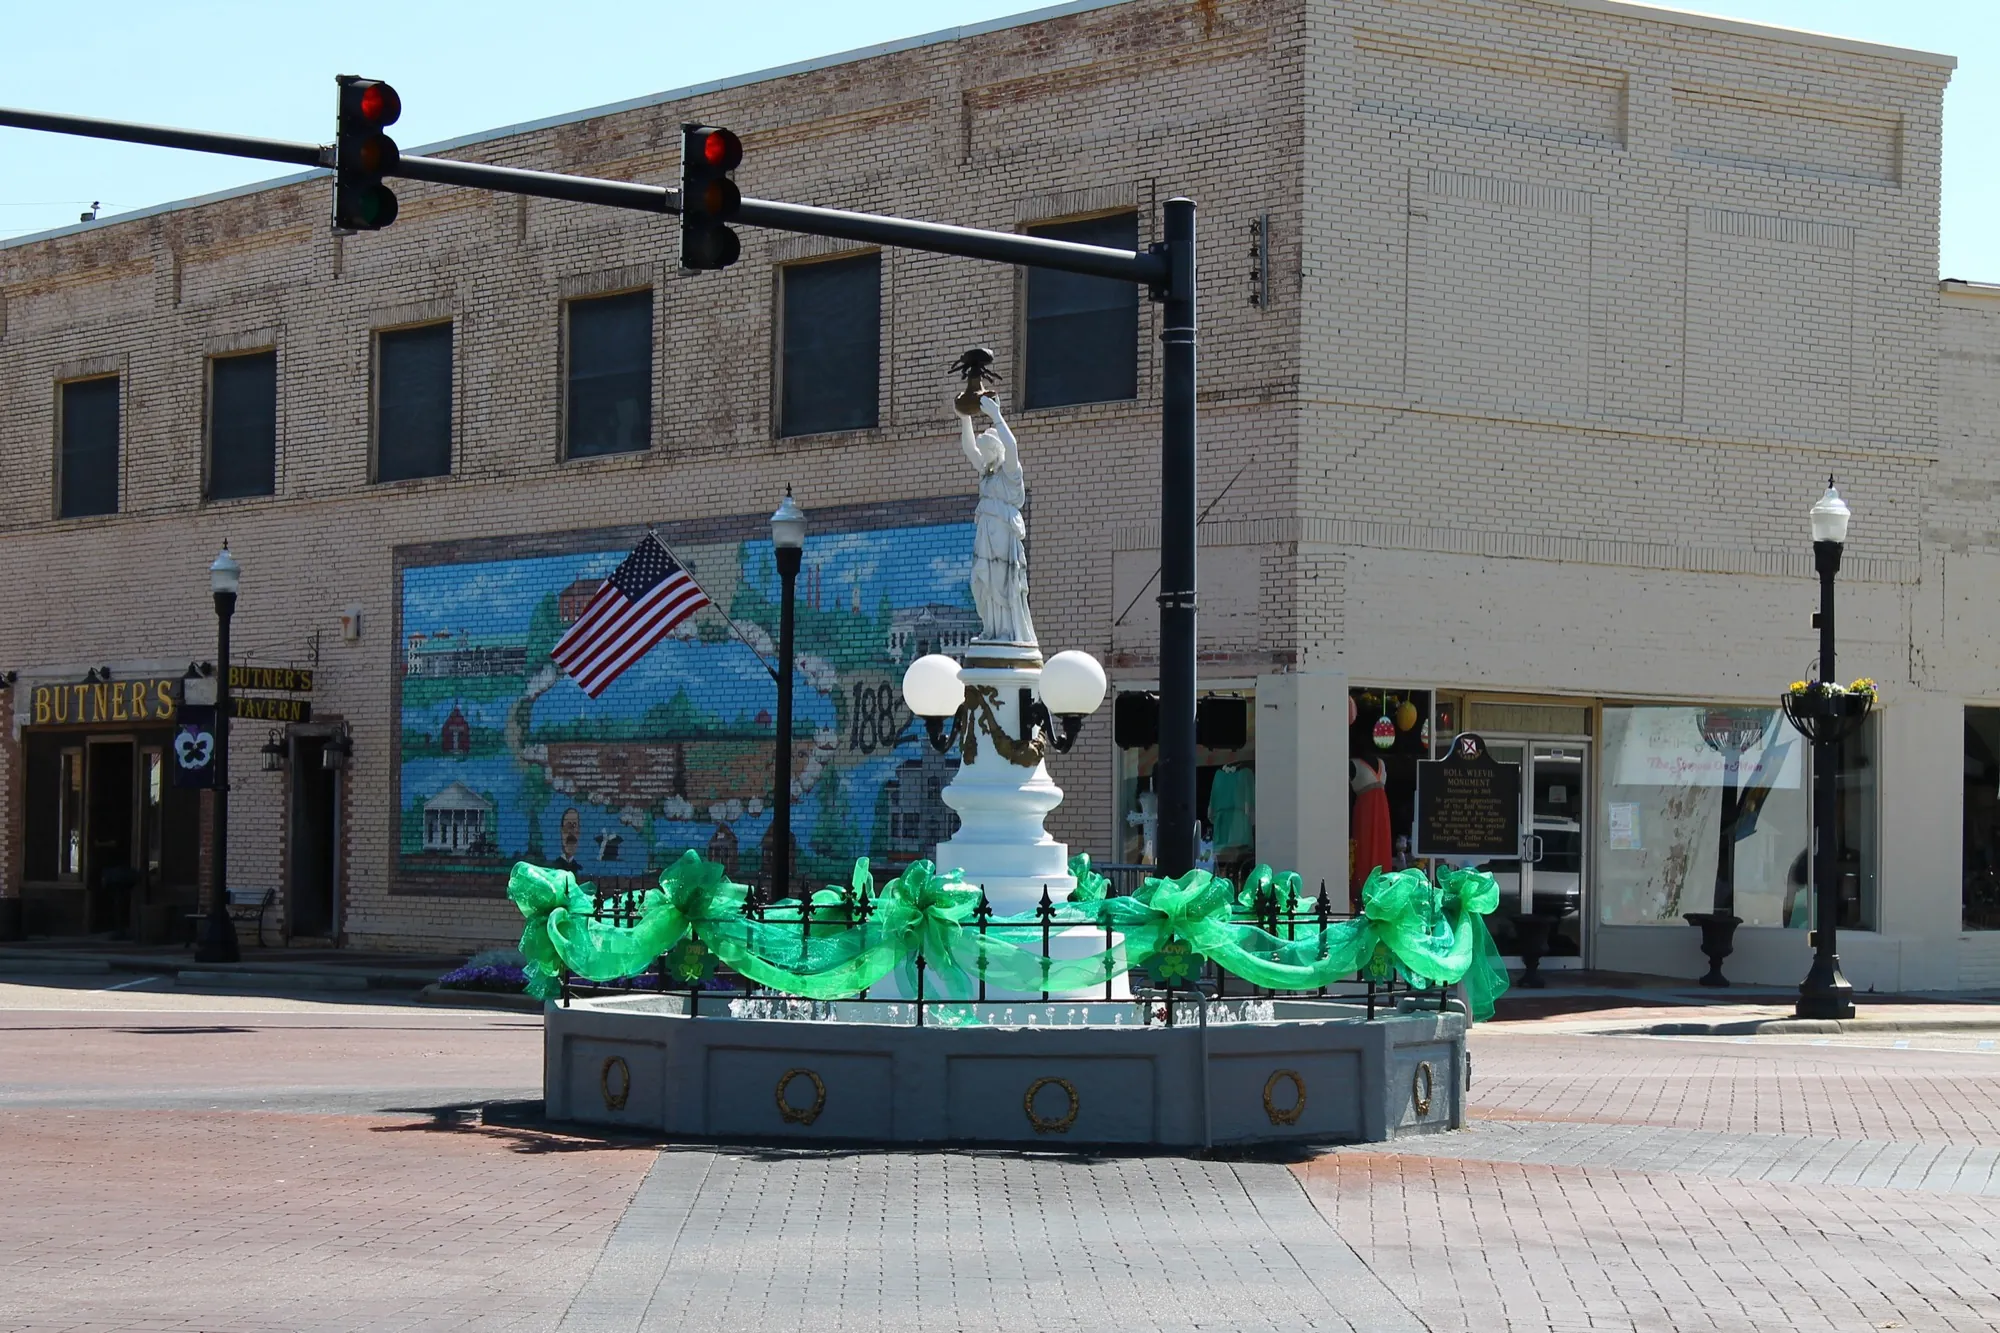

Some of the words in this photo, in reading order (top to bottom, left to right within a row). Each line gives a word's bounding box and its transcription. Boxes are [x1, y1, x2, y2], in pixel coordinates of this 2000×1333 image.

[229, 666, 313, 690] BUTNER'S
[35, 680, 175, 724] BUTNER'S
[235, 697, 301, 720] TAVERN
[1443, 768, 1463, 777] BOLL
[1466, 768, 1495, 778] WEEVIL
[1447, 778, 1491, 787] MONUMENT
